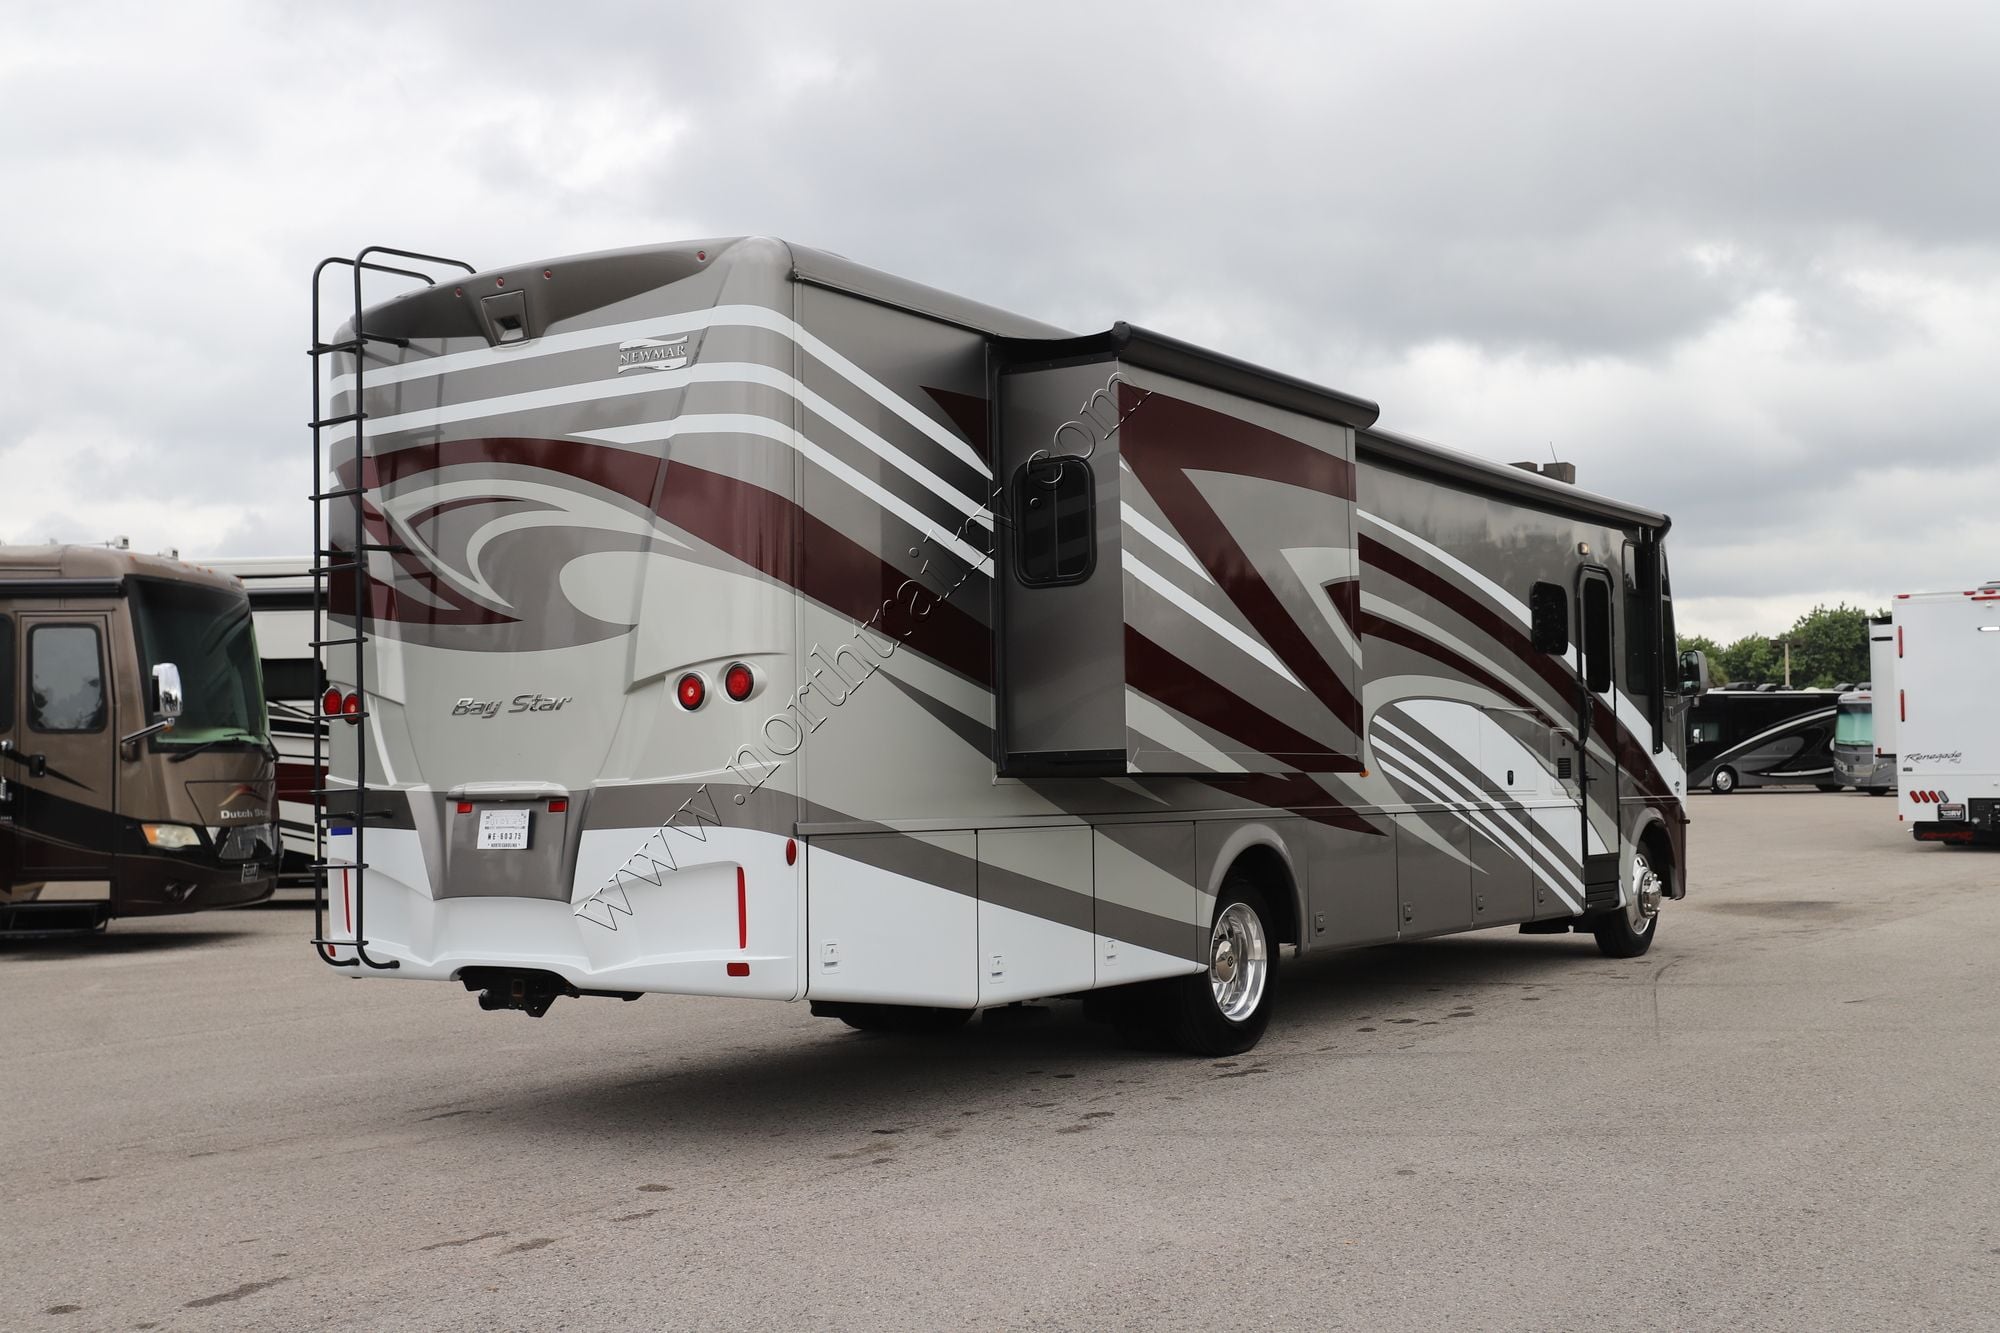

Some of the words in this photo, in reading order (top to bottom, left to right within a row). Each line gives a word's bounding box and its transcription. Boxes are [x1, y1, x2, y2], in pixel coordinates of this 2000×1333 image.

[620, 345, 686, 365] NEWMAR
[452, 697, 503, 719] Bay
[508, 694, 573, 714] Star
[1904, 750, 1962, 764] Renegade
[221, 809, 253, 819] Dutch
